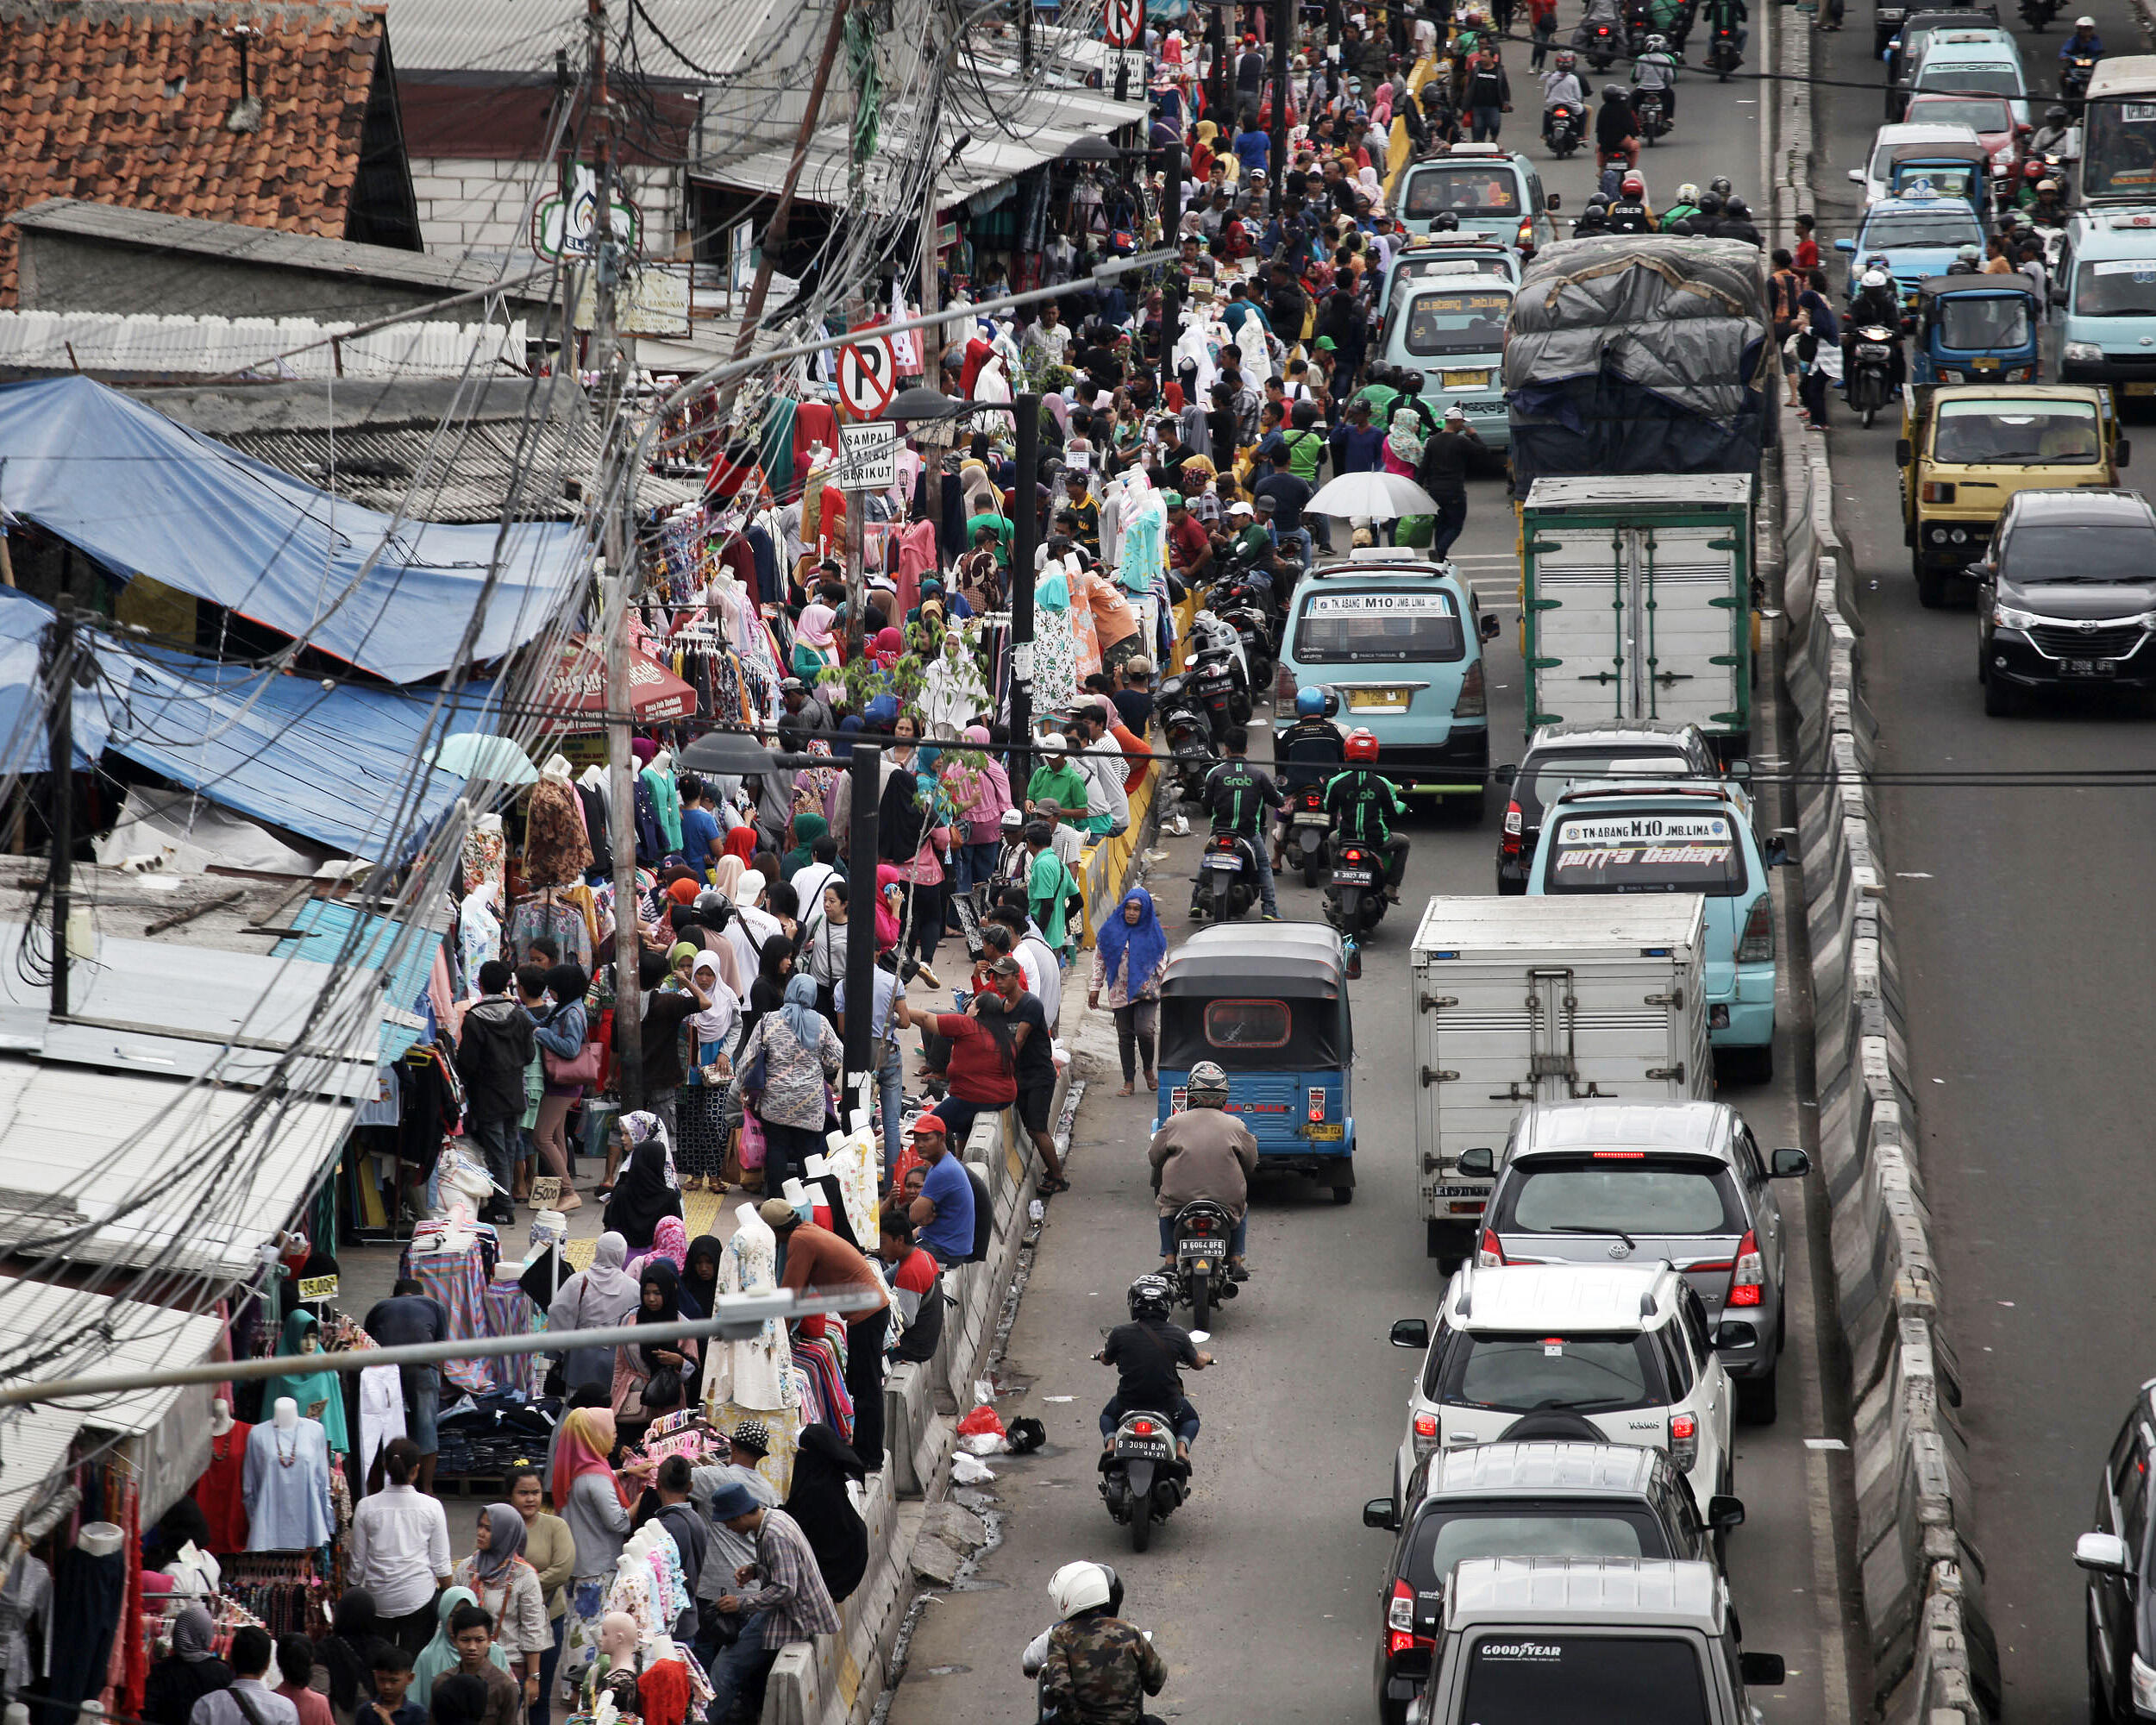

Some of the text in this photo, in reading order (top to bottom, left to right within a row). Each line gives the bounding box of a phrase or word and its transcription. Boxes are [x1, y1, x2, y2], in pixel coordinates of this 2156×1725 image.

[847, 431, 888, 446] SAMPAI
[843, 466, 892, 481] BERIKUT
[1342, 599, 1360, 609] ABANG
[1365, 598, 1393, 608] M10
[1412, 598, 1426, 607] LIMA
[664, 696, 682, 708] Terbaik
[1223, 775, 1253, 787] Grab
[1631, 820, 1663, 837] M.10
[1150, 1442, 1166, 1452] BJM
[1482, 1643, 1561, 1657] GOODYEAR
